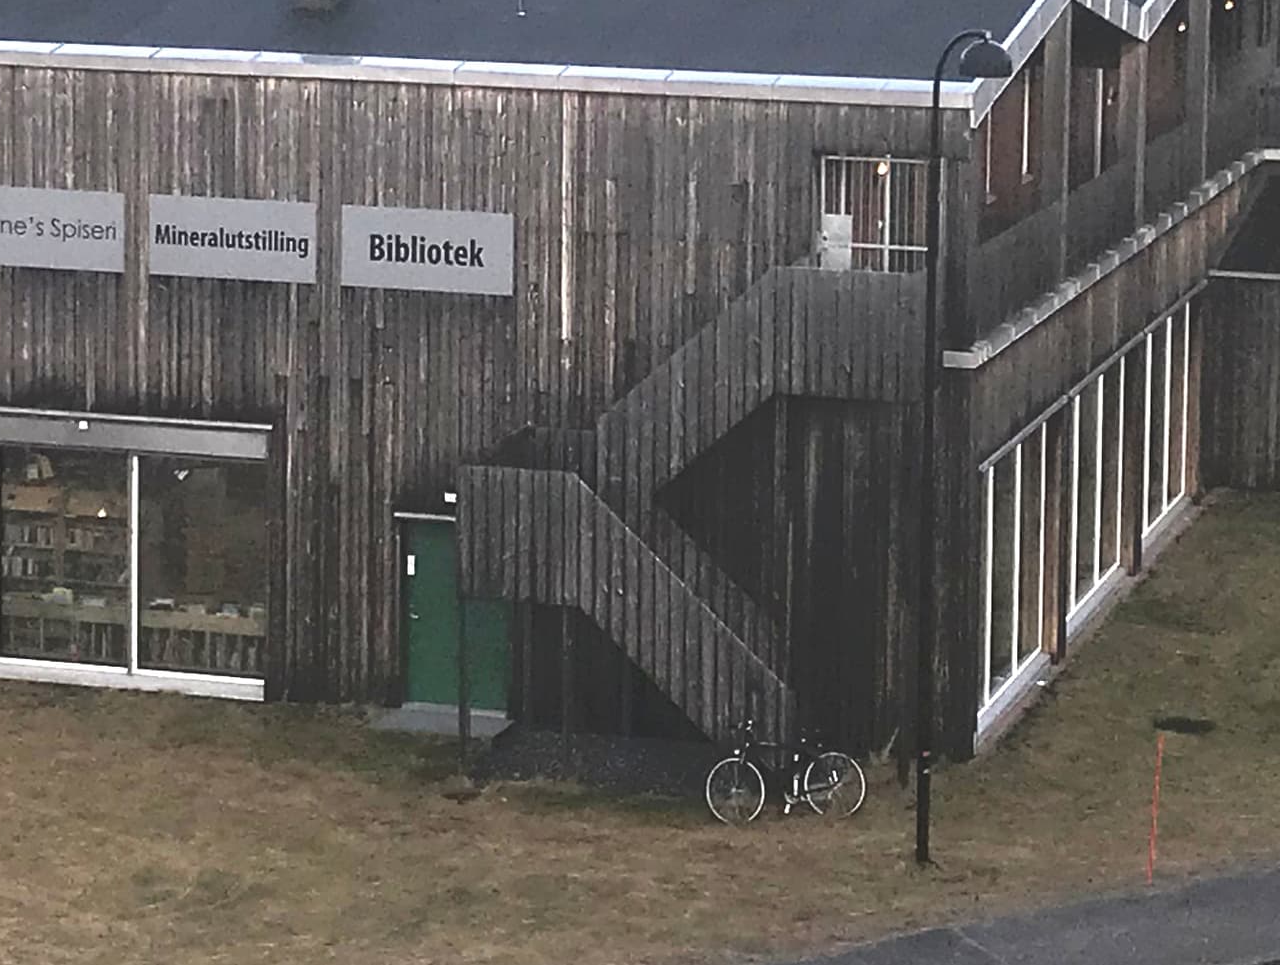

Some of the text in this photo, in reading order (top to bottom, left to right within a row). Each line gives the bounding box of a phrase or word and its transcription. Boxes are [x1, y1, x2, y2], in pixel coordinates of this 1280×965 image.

[50, 218, 117, 242] Spiseri
[155, 224, 309, 258] Mineralutstilling
[370, 234, 484, 267] Bibliotek
